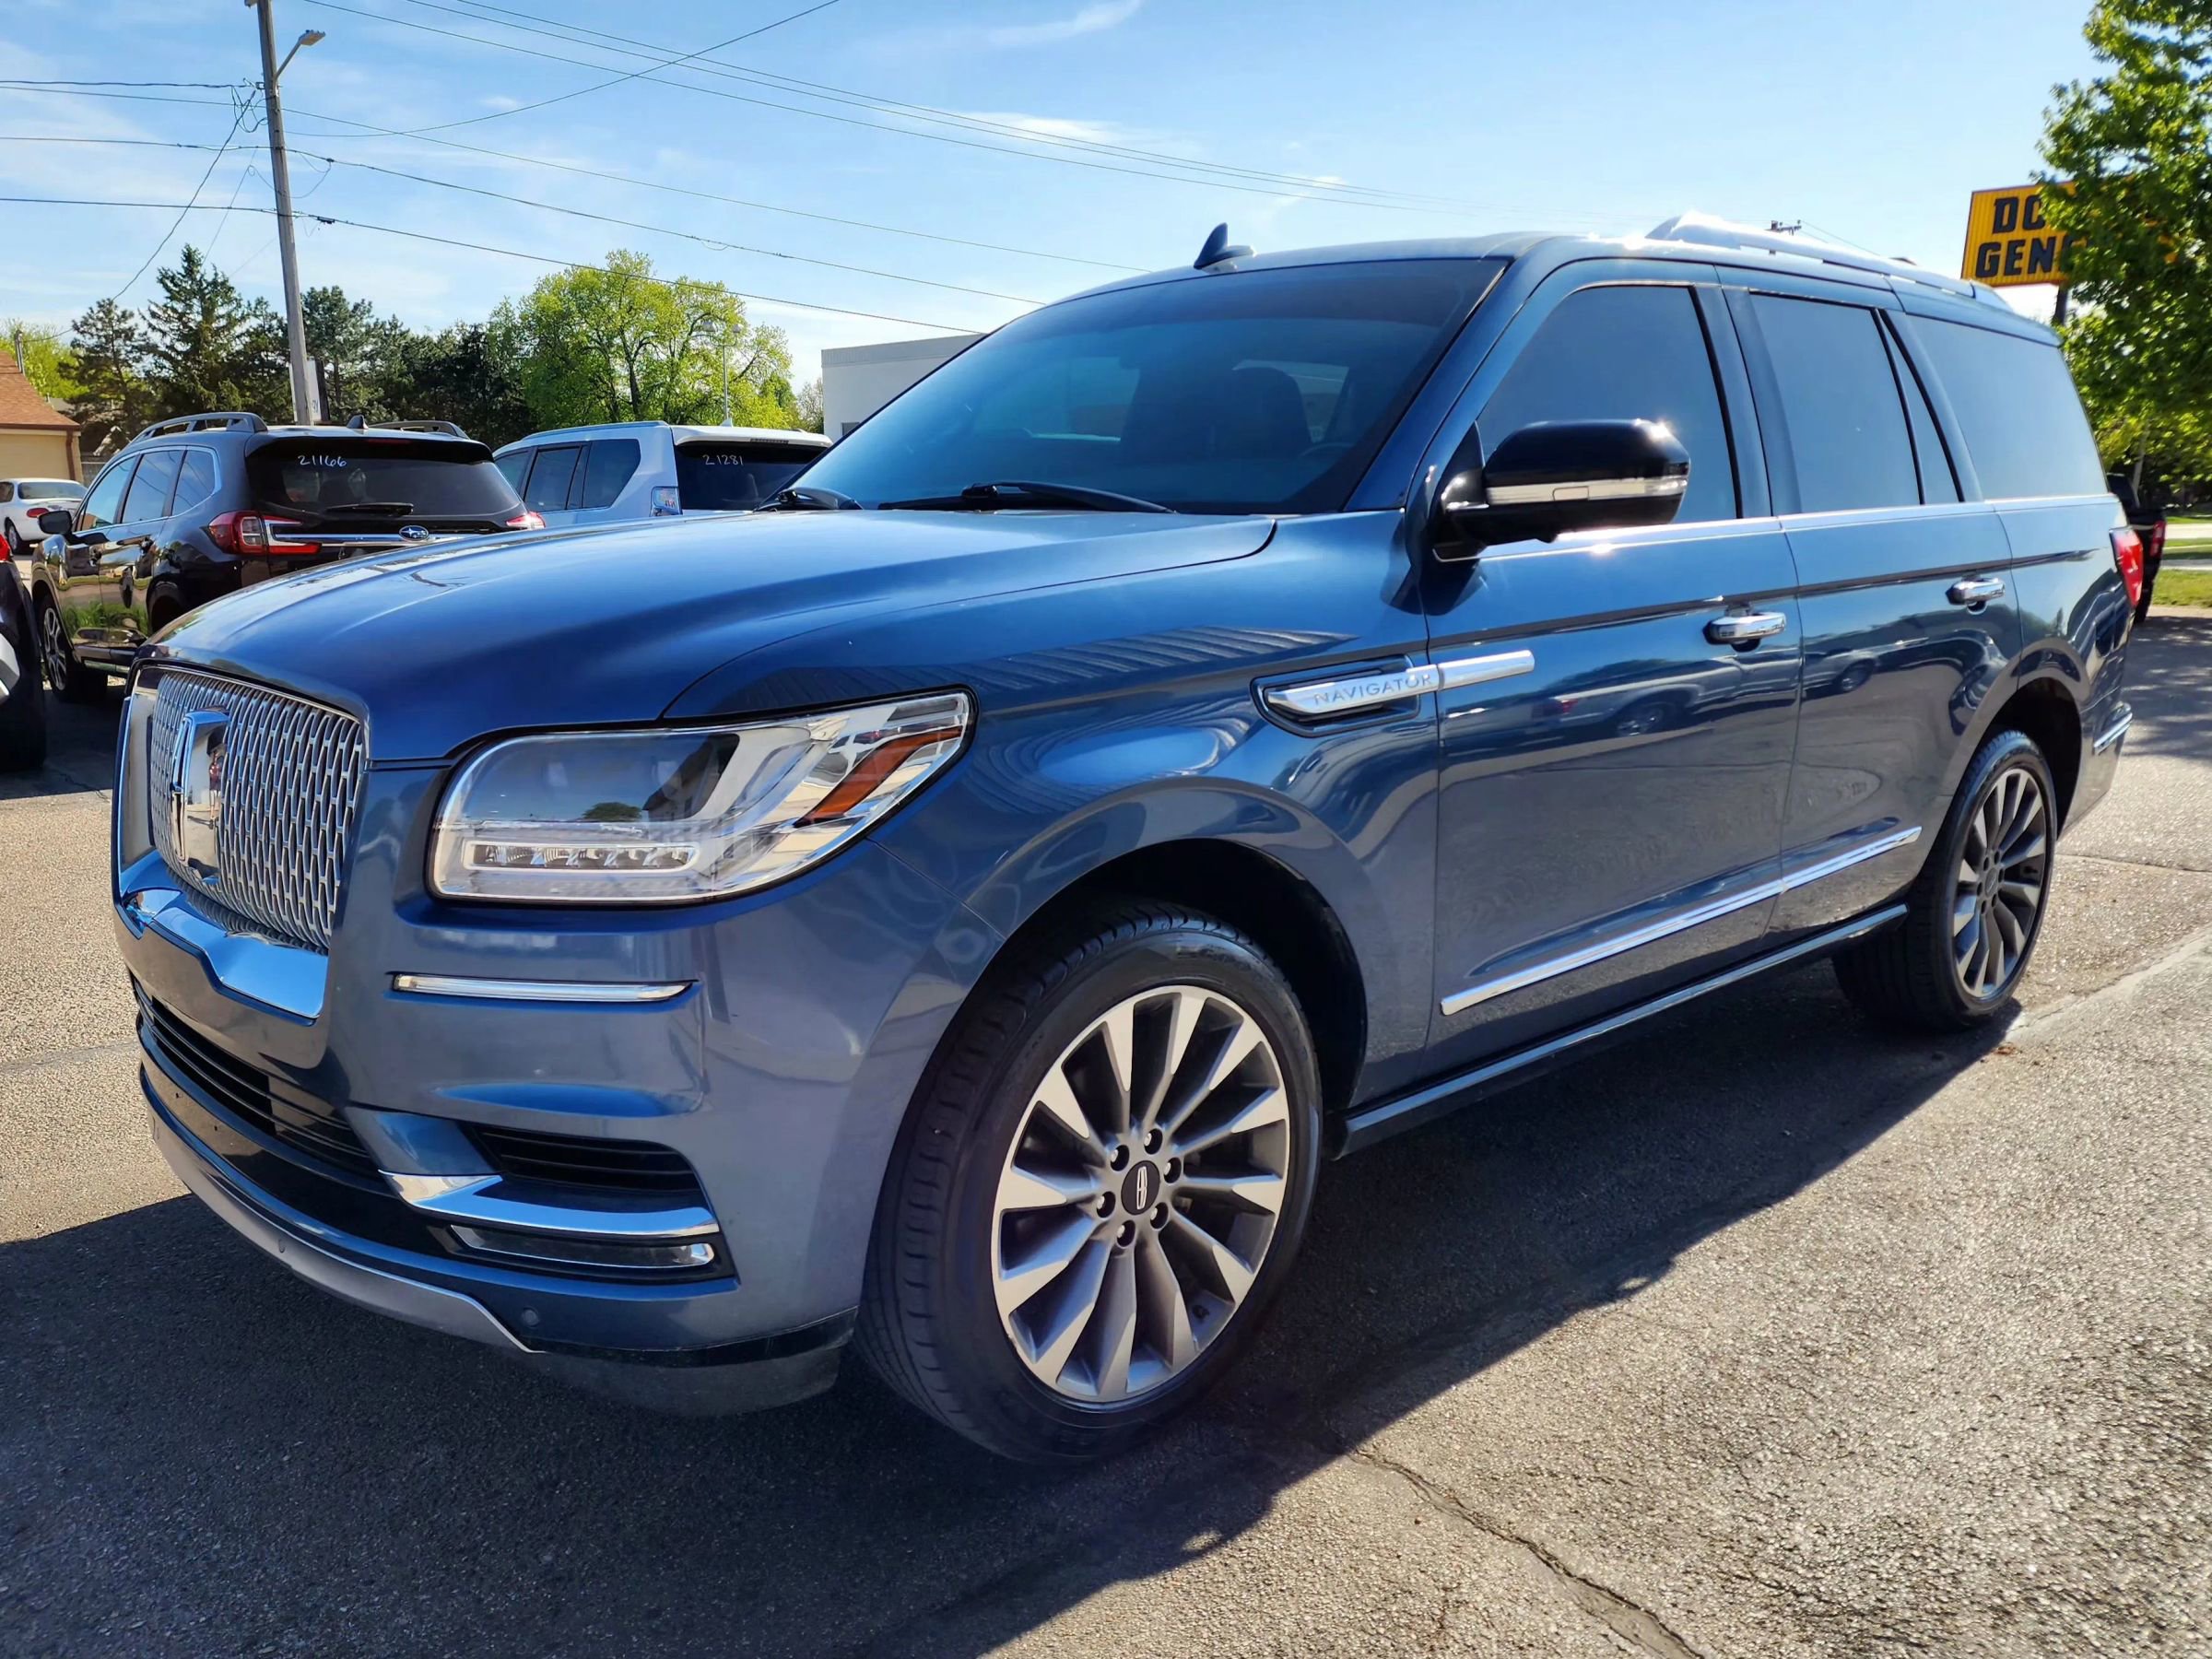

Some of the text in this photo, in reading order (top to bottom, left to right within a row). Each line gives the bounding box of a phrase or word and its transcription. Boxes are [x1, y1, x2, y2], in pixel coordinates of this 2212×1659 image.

[298, 454, 347, 467] 21166
[702, 453, 744, 466] 21281
[1313, 672, 1431, 706] NAVIGATOR
